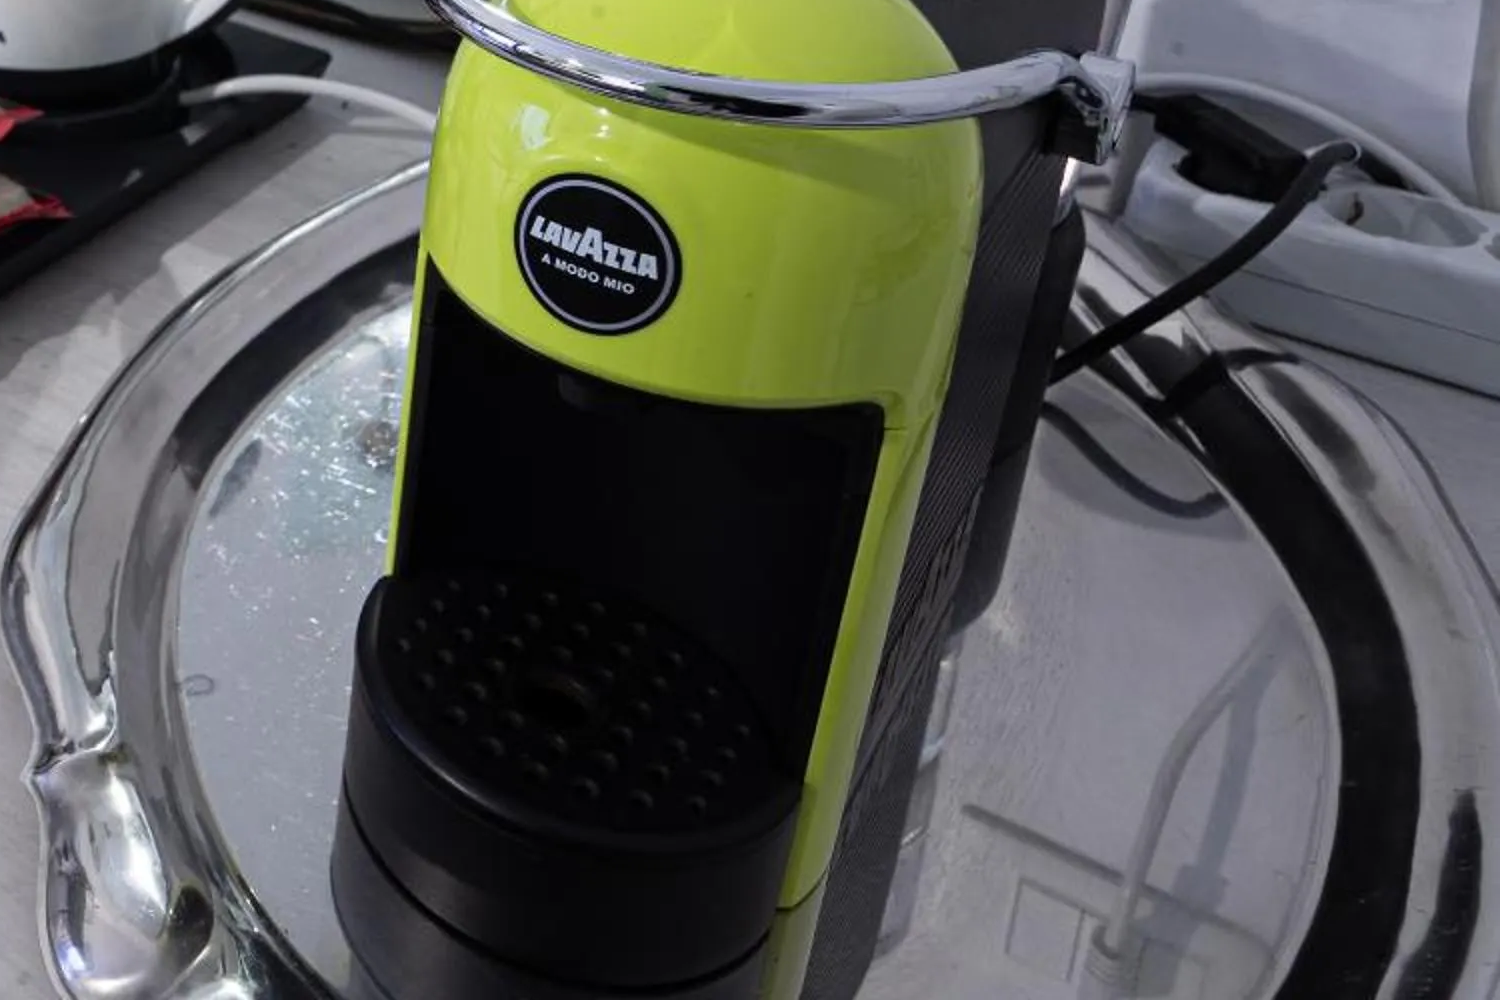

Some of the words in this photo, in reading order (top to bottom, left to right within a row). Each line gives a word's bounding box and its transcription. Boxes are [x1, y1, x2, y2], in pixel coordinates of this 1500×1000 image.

[529, 215, 659, 280] LAVAZZA
[541, 253, 551, 265] A
[554, 258, 600, 283] MODO
[603, 276, 636, 294] MIO
